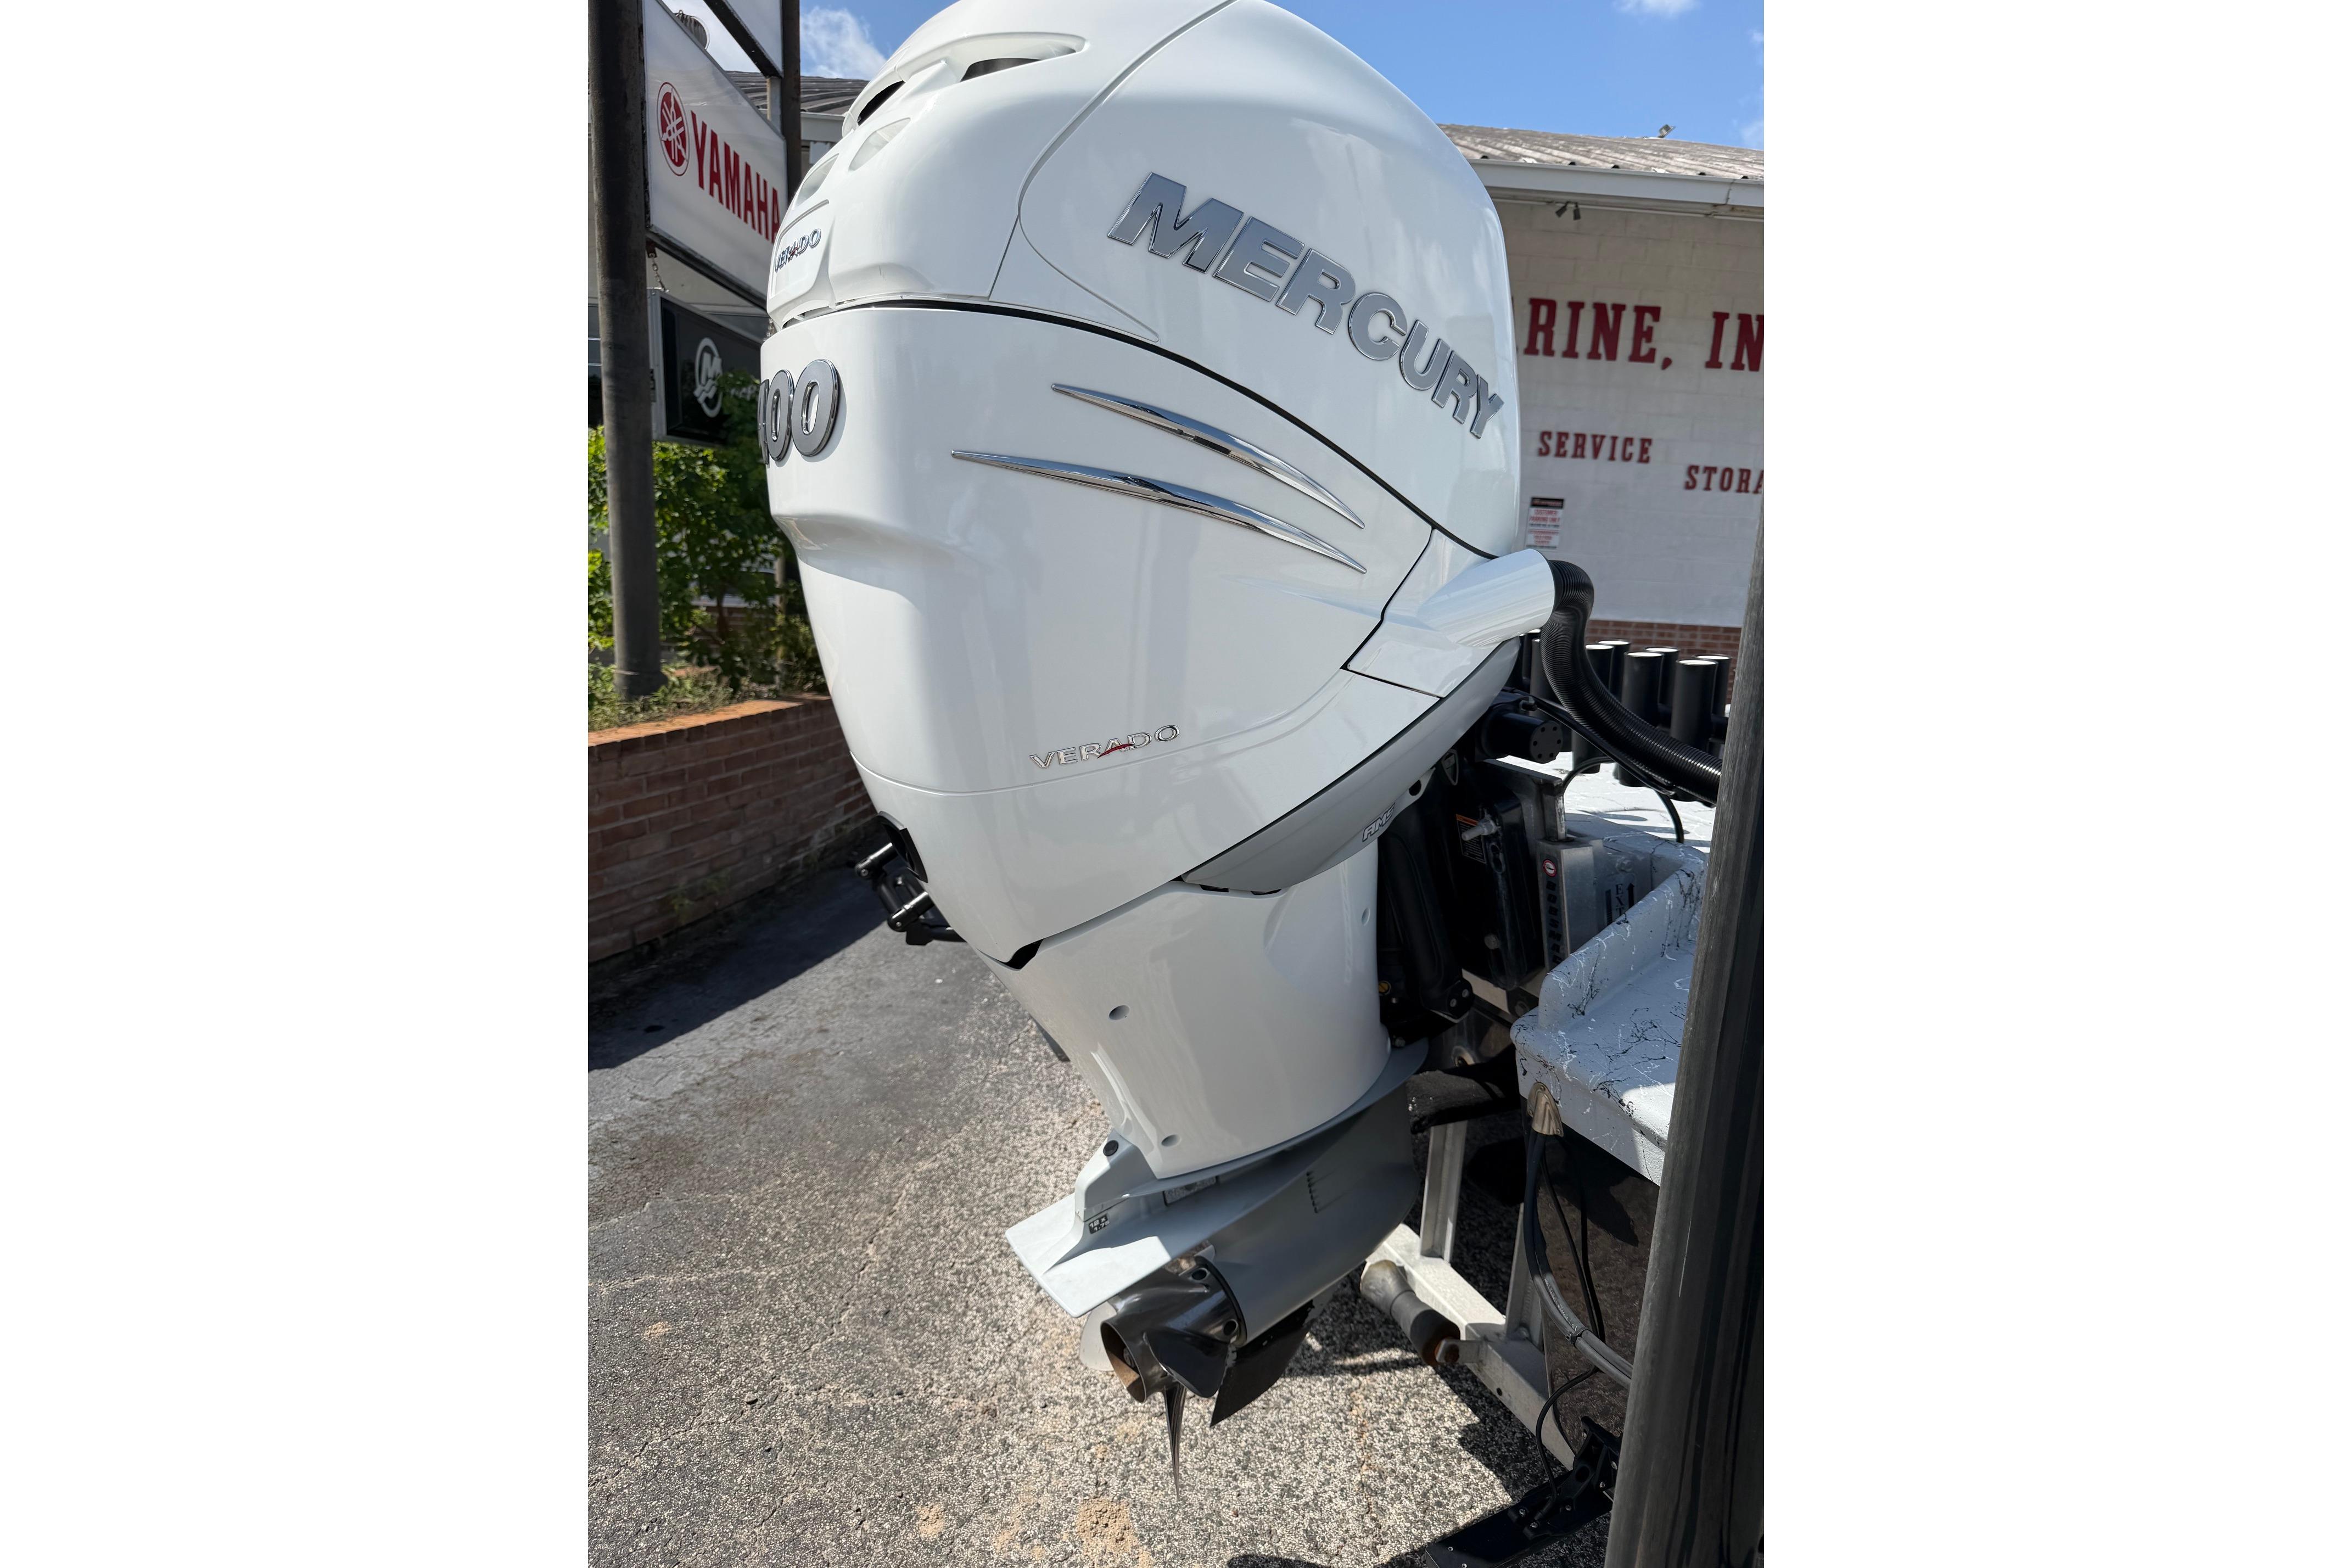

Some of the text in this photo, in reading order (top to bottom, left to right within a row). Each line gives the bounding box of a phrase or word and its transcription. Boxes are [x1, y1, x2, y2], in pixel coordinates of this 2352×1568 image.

[691, 110, 781, 244] YAMAHA
[775, 228, 821, 273] VERADO
[1107, 172, 1505, 440] MERCURY
[1516, 297, 1672, 371] RINE,
[1538, 431, 1653, 463] SERVICE
[1029, 725, 1180, 769] VERADO
[1362, 802, 1395, 842] AMS
